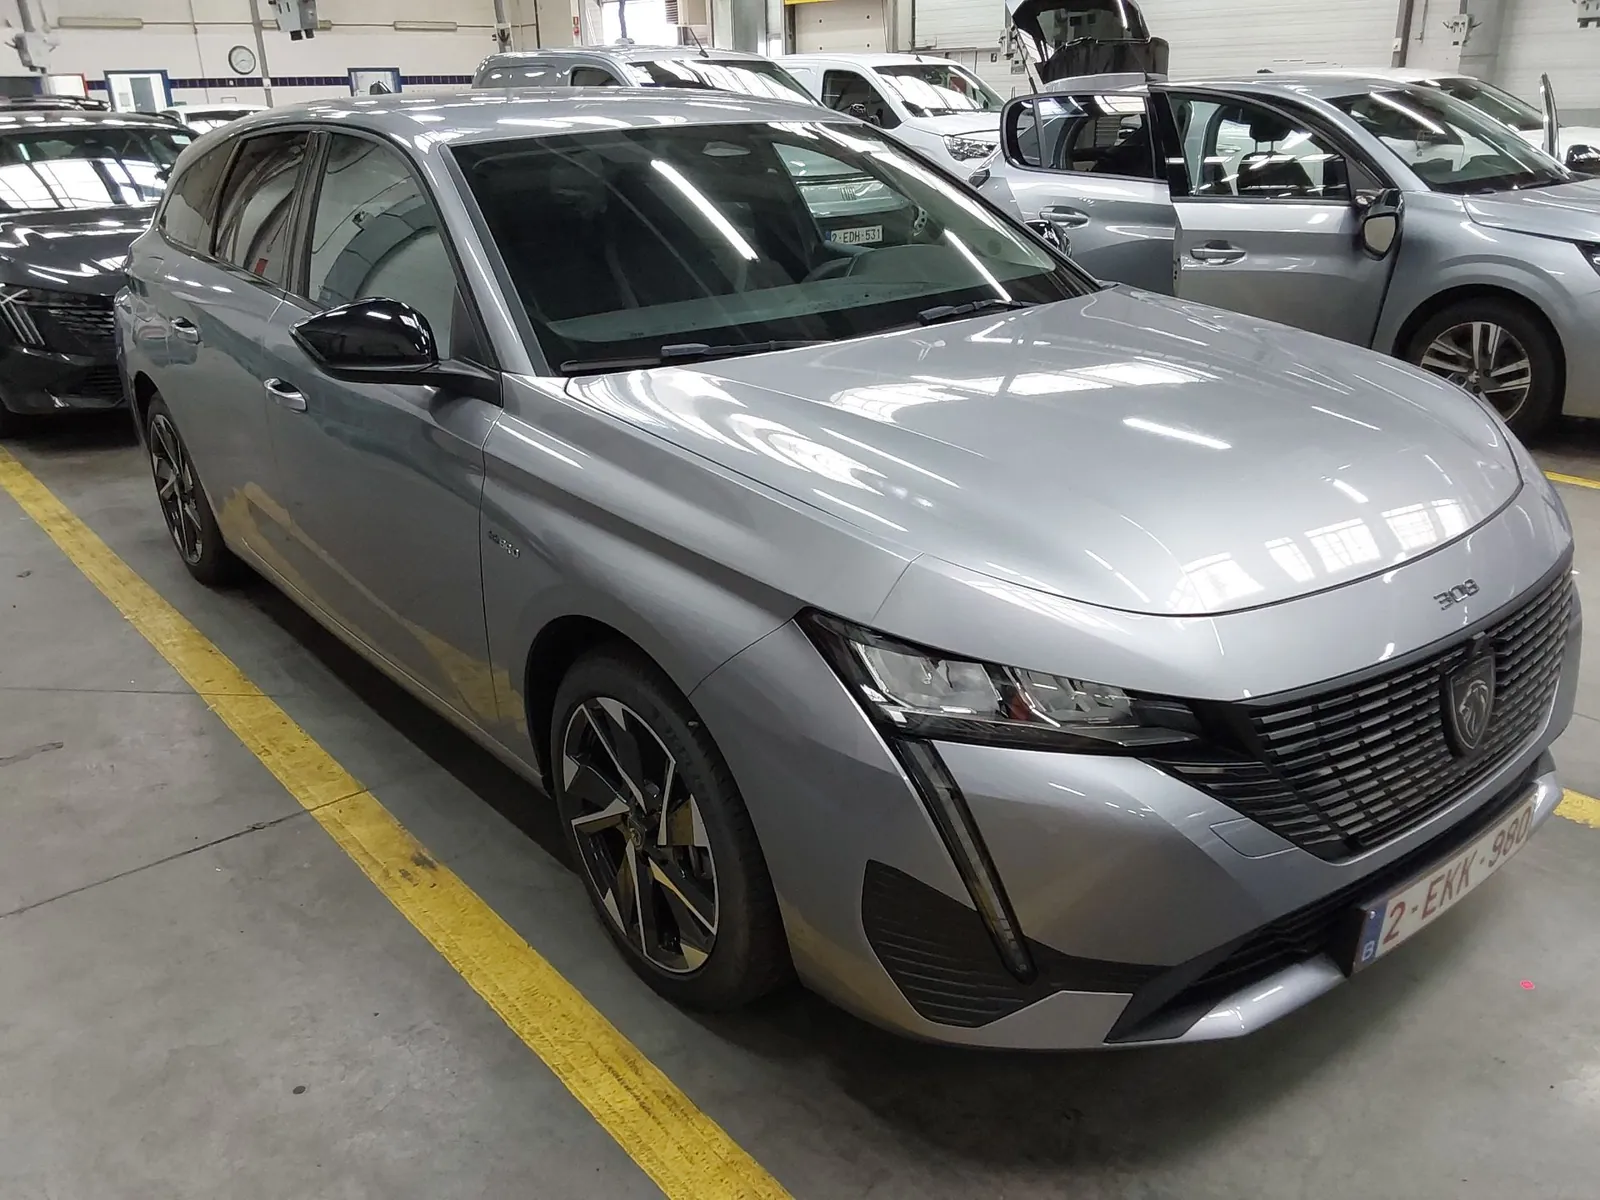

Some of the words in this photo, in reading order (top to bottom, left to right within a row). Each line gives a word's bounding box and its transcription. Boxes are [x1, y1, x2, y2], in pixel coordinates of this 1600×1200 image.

[1433, 578, 1479, 610] 308
[1382, 806, 1532, 945] 2-EKK-980
[1361, 940, 1375, 961] B
